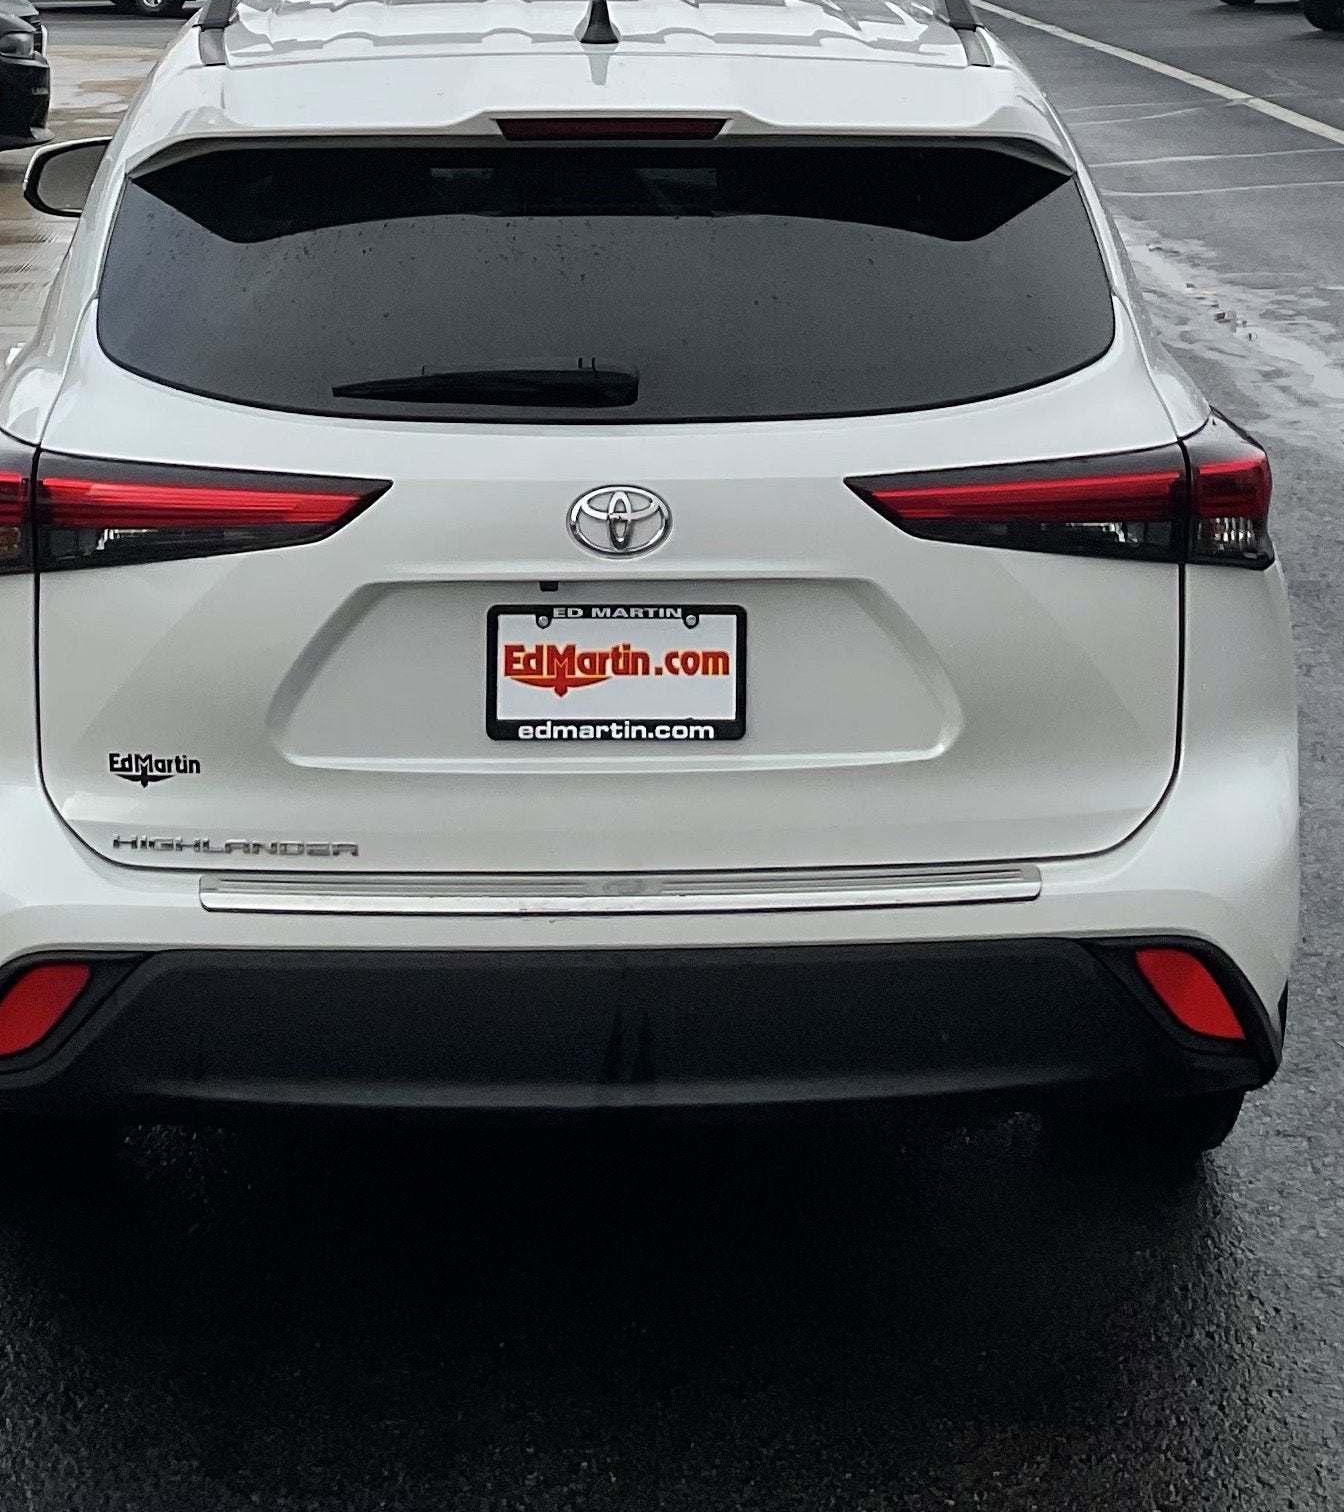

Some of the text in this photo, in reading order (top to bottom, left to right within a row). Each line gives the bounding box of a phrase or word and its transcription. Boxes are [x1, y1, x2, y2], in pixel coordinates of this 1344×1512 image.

[552, 607, 683, 618] ED MARTIN
[517, 721, 715, 739] edmartin.com
[112, 835, 359, 857] HIGHLANDER
